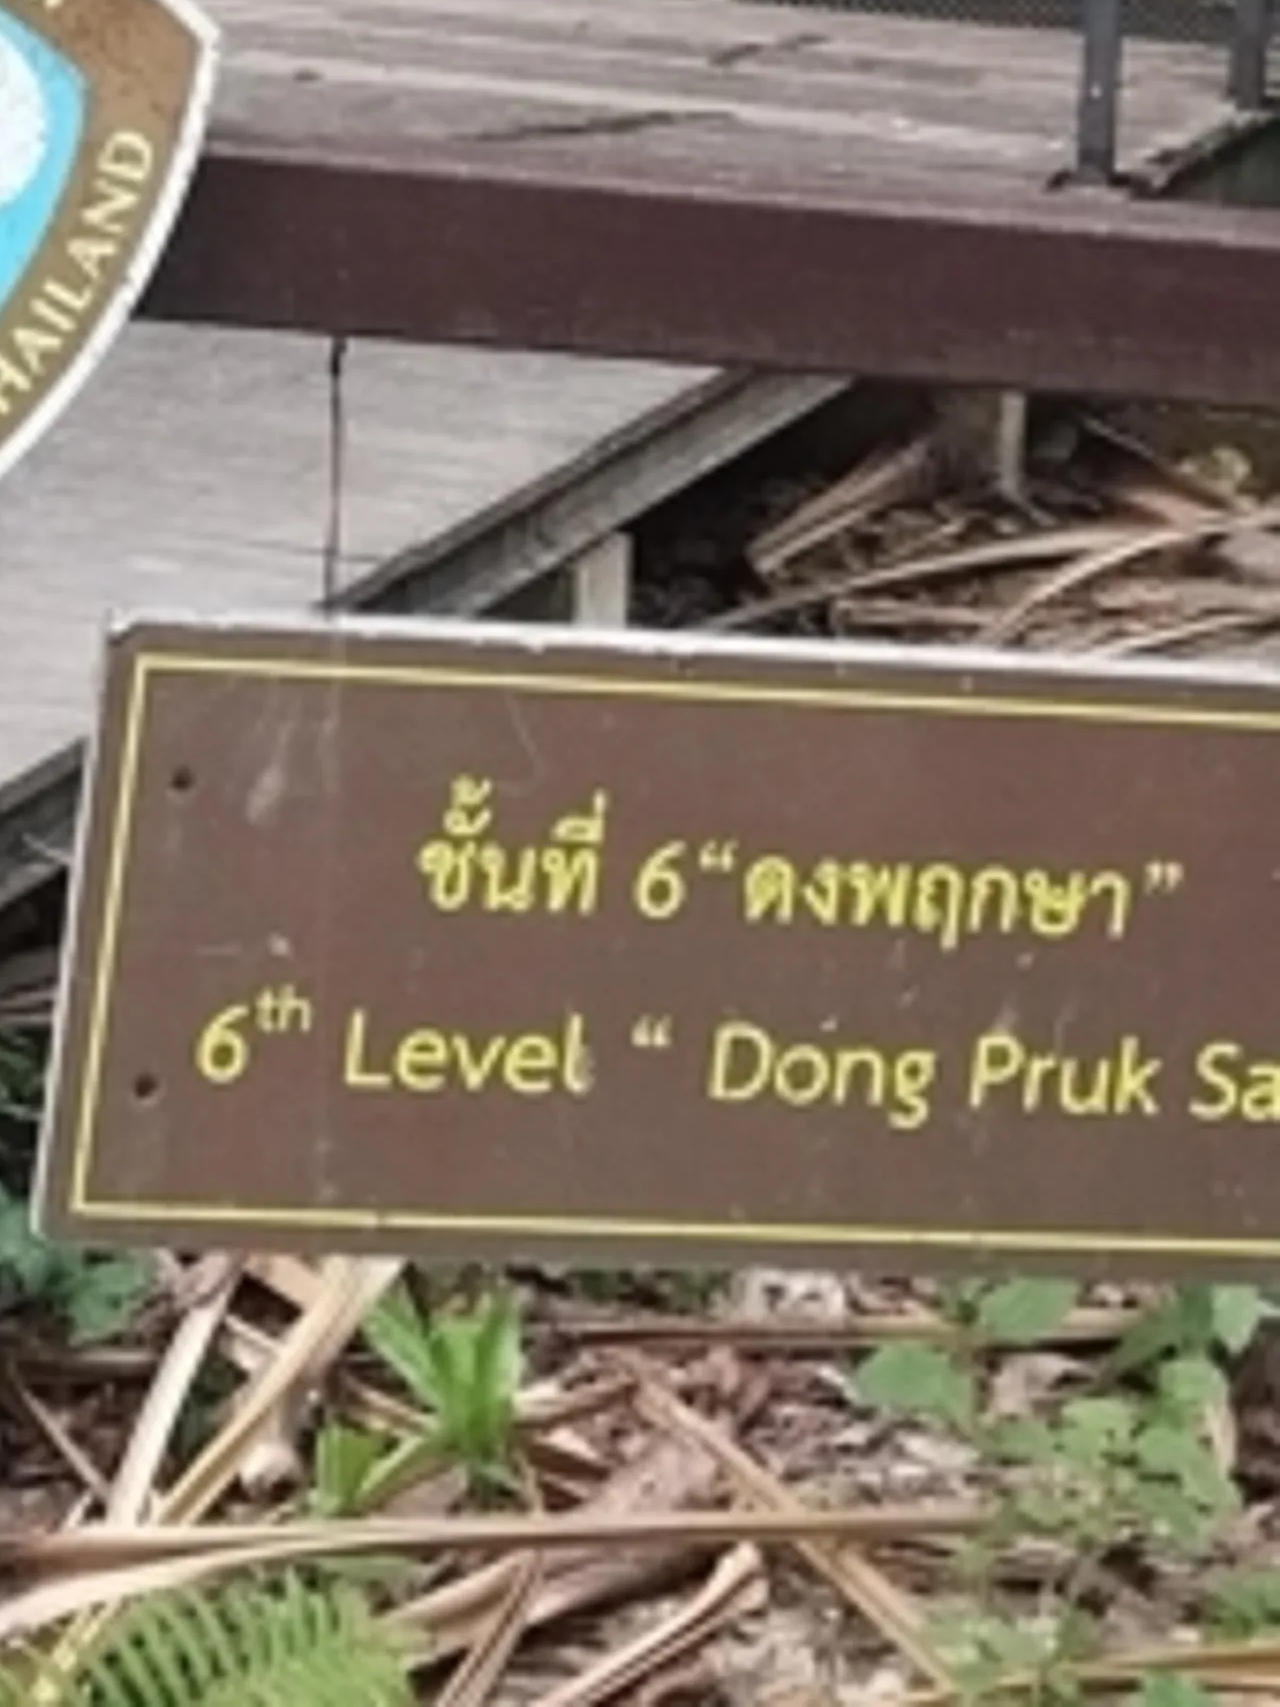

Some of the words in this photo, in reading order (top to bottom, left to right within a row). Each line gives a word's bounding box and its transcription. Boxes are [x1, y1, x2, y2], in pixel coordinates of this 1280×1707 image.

[416, 775, 607, 913] ชั้นที่
[344, 1008, 589, 1094] Level
[707, 1023, 935, 1129] Dong
[968, 1034, 1163, 1116] Pruk
